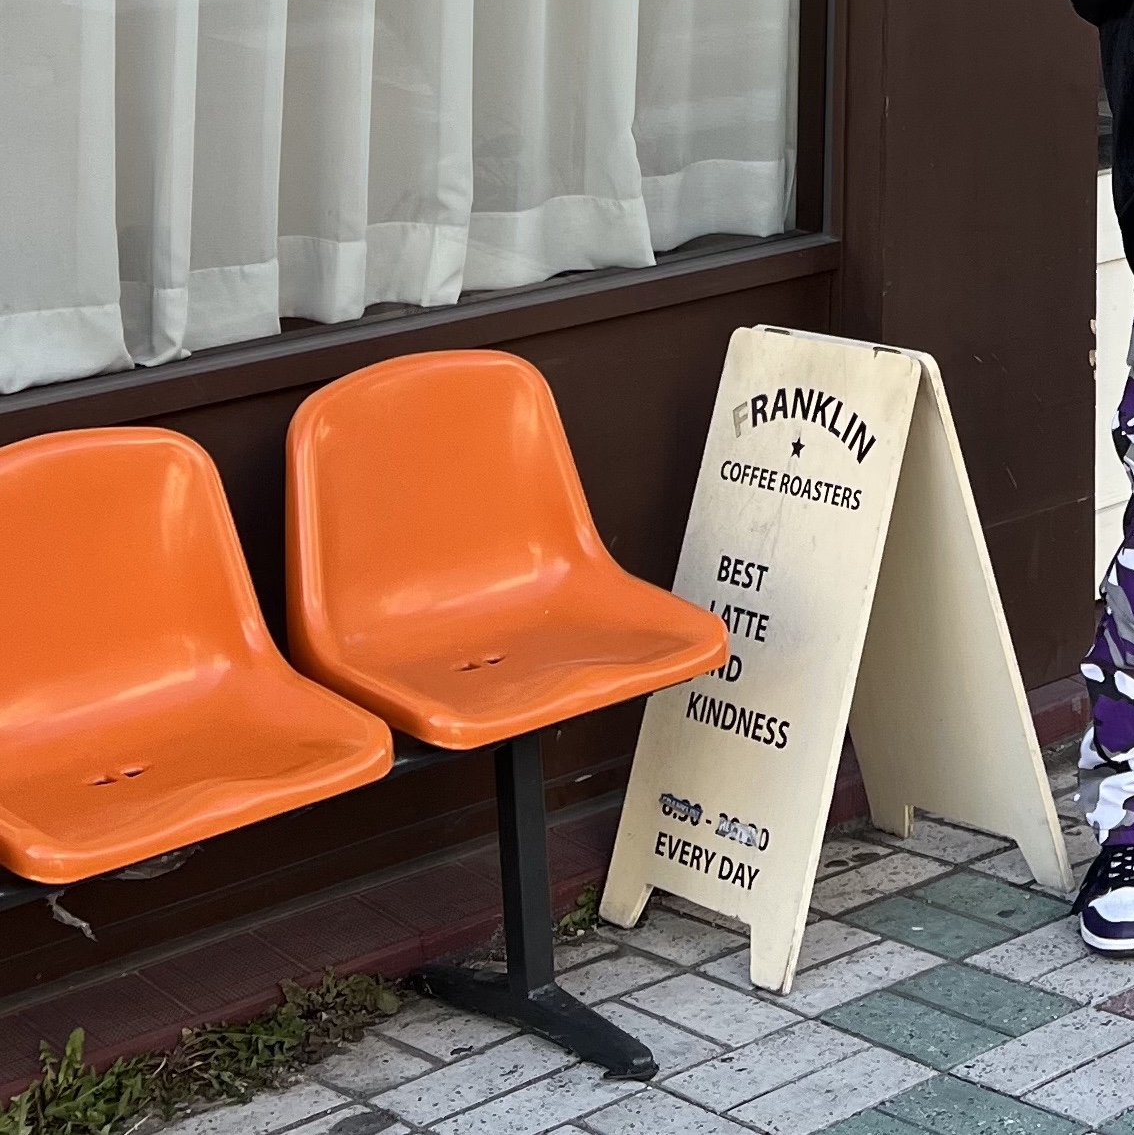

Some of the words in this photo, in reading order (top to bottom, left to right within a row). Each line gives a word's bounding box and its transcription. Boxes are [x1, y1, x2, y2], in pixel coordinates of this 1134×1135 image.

[732, 387, 877, 465] FRANKLIN
[720, 460, 778, 491] COFFEE
[778, 472, 863, 511] ROASTERS
[716, 554, 769, 592] BEST
[685, 690, 790, 749] KINDNESS
[654, 831, 717, 874] EVERY
[717, 855, 760, 891] DAY
